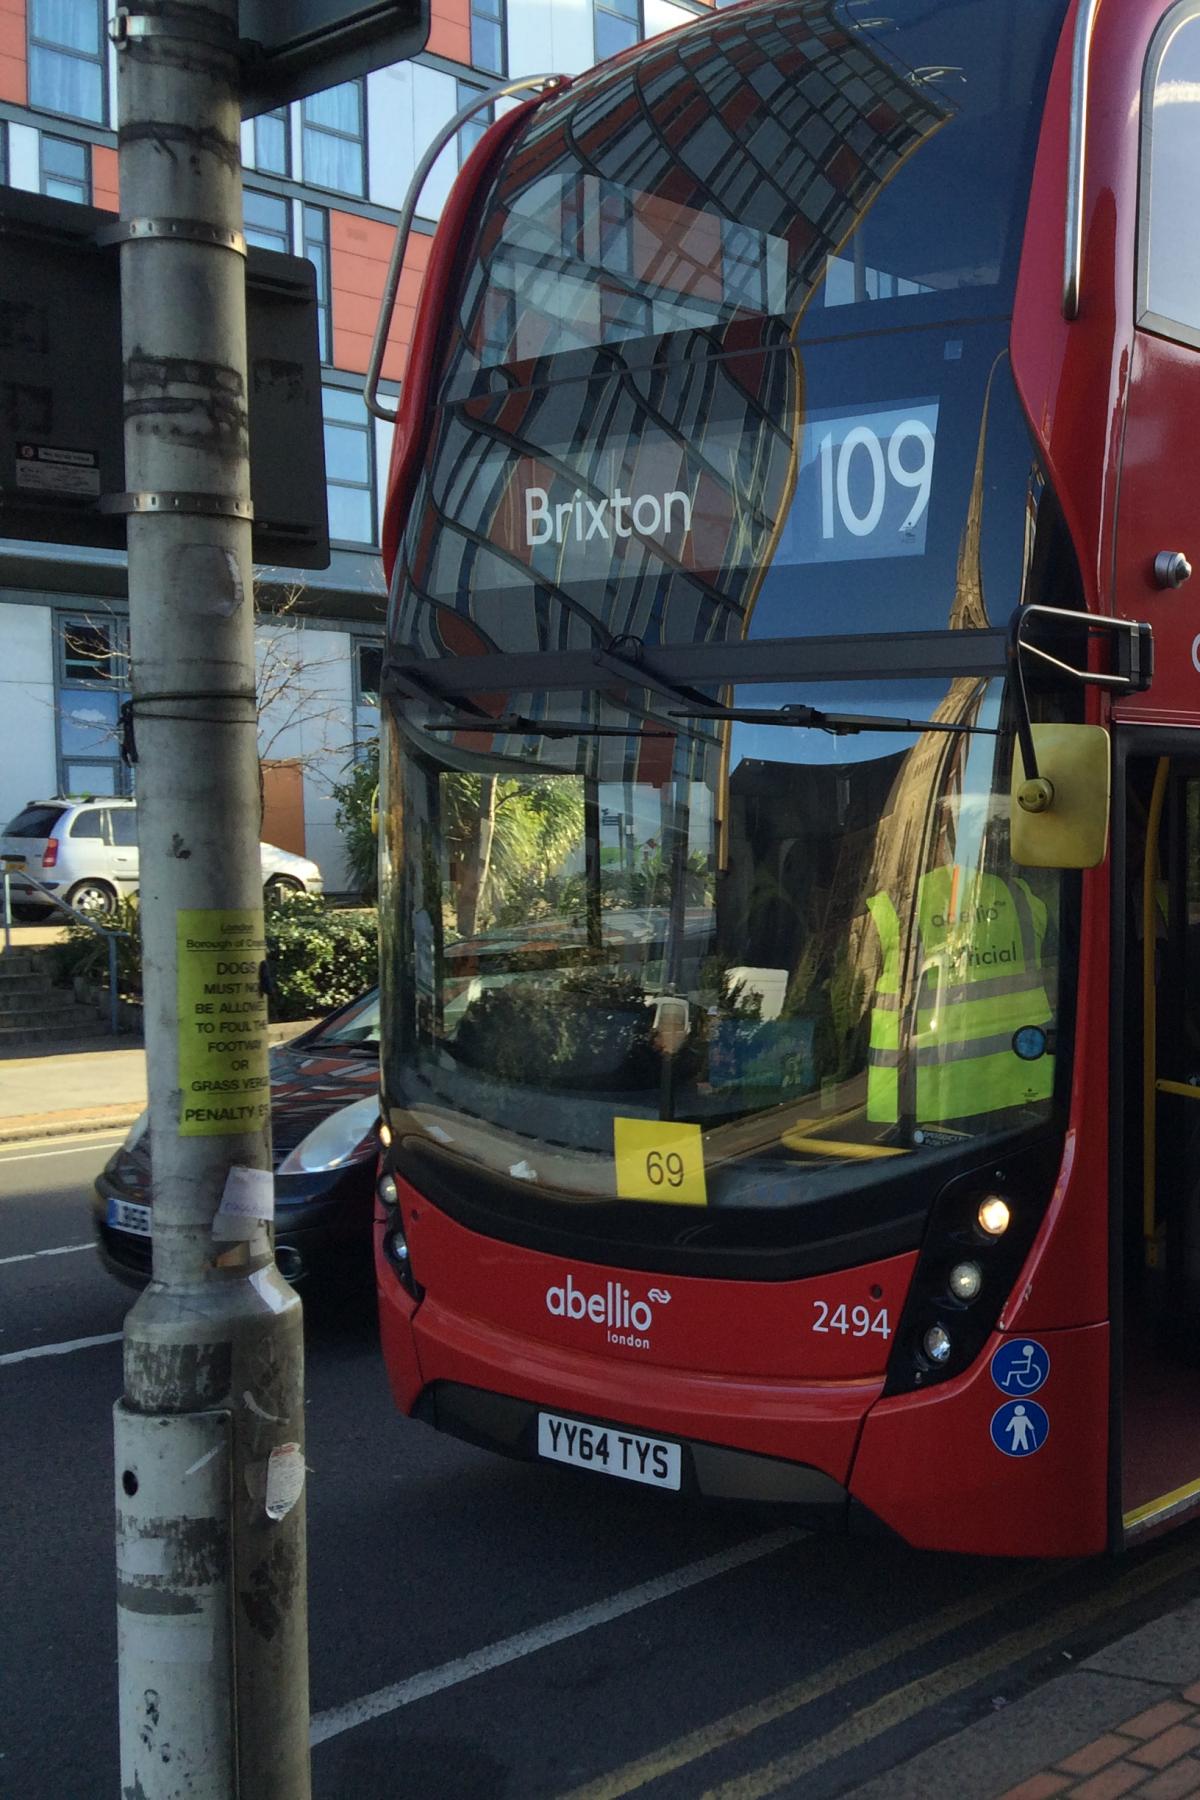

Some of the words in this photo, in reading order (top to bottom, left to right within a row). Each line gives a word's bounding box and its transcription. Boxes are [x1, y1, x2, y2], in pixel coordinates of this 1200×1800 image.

[820, 419, 936, 539] 109
[525, 487, 692, 546] Brixton
[186, 939, 233, 950] Borough
[235, 939, 245, 949] of
[216, 961, 257, 976] DOGS
[203, 983, 242, 995] MUST
[195, 1002, 215, 1015] BE
[195, 1022, 216, 1034] TO
[220, 1021, 252, 1034] FOUL
[230, 1059, 249, 1071] OR
[191, 1079, 240, 1092] GRASS
[184, 1105, 256, 1122] PENALTY
[646, 1151, 684, 1188] 69
[546, 1274, 653, 1332] abellio
[812, 1300, 892, 1340] 2494
[607, 1330, 650, 1350] london
[548, 1419, 610, 1466] YY64
[618, 1436, 669, 1479] TYS
